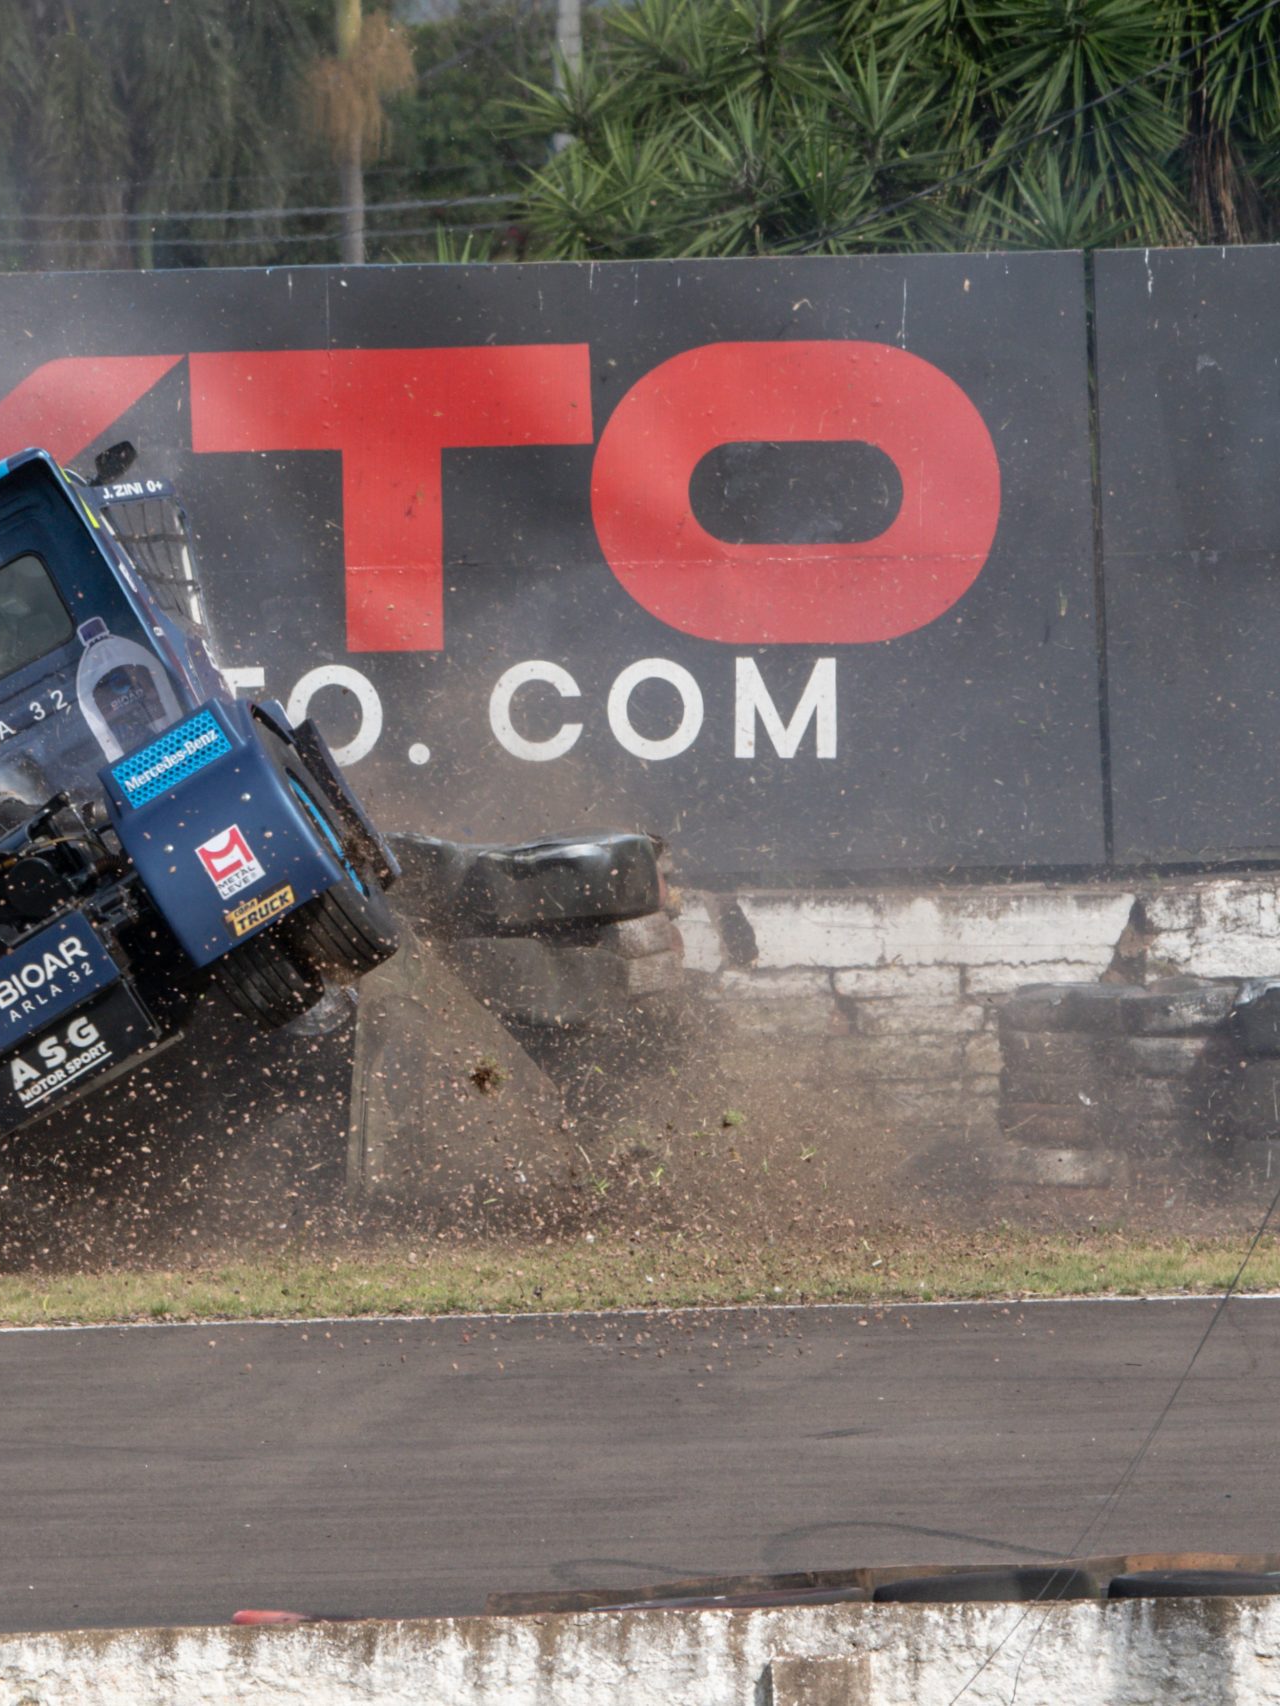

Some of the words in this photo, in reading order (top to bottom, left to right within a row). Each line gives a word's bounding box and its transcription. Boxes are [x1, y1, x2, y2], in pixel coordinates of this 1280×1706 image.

[102, 487, 114, 499] J.
[113, 482, 143, 497] ZINI
[123, 729, 219, 793] Mercedes-Benz
[218, 865, 256, 890] METAL
[236, 890, 290, 931] TRUCK
[9, 984, 63, 1023] ARLA
[68, 961, 94, 984] 32
[18, 1066, 68, 1102] MOTOR
[64, 1040, 108, 1075] SPORT
